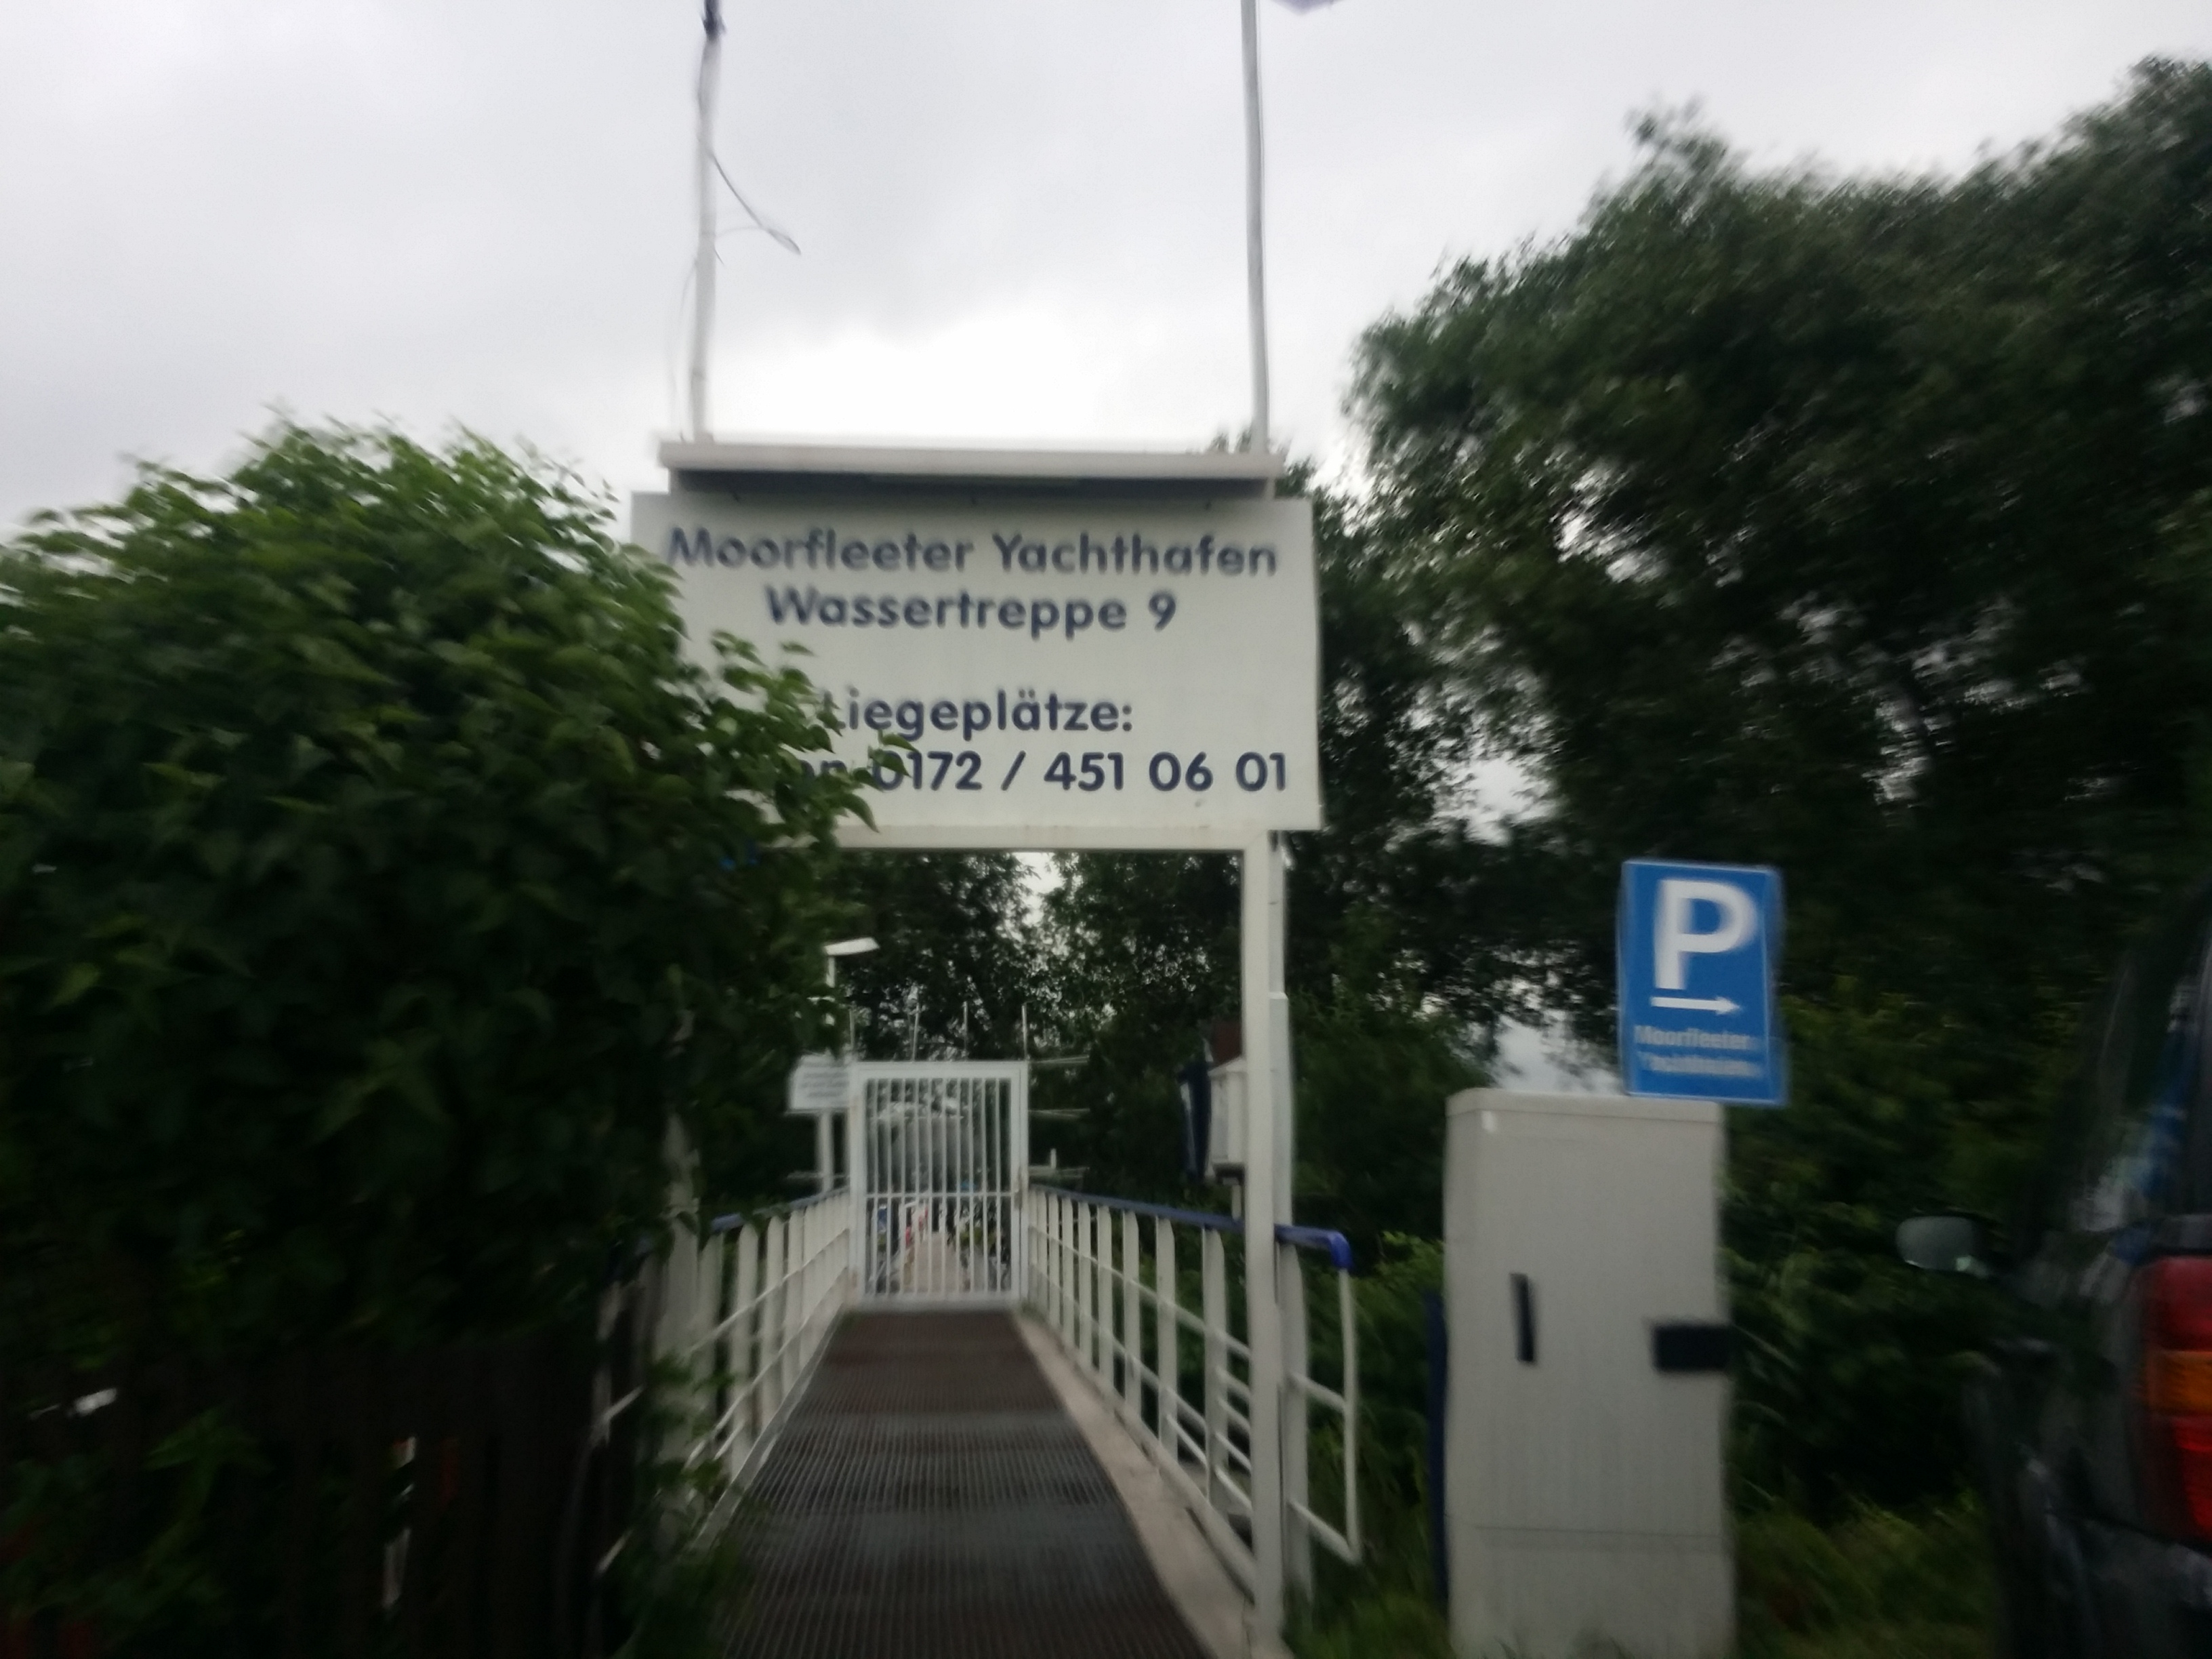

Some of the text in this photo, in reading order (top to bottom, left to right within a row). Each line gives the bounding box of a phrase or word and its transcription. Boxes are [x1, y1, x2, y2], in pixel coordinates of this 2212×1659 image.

[668, 527, 1278, 577] Moorfleeter Yachthafen
[766, 583, 1177, 640] Wassertreppe 9
[872, 750, 983, 791] 0172
[1000, 750, 1027, 791] /
[1044, 751, 1124, 791] 451
[1149, 751, 1214, 792] 06
[1235, 751, 1286, 792] 01
[1654, 880, 1759, 990] P
